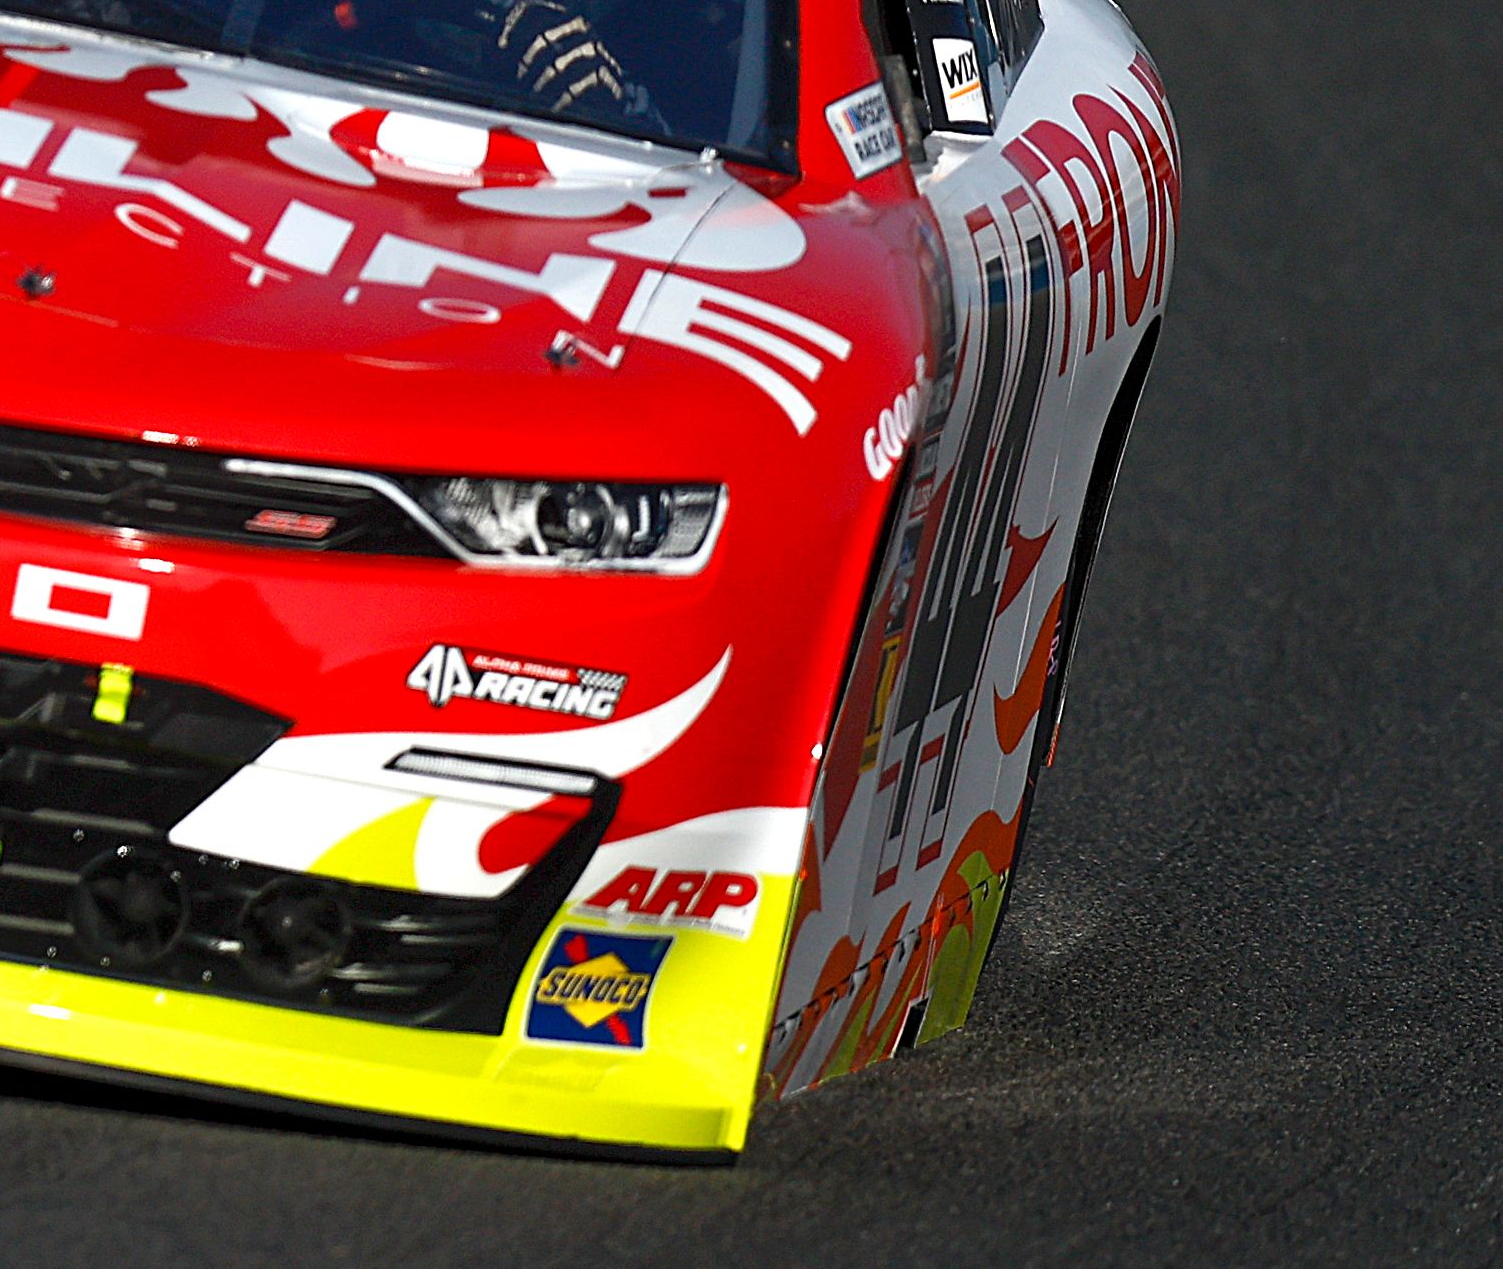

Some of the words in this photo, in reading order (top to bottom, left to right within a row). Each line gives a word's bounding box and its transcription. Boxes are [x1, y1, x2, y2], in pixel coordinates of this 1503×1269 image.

[942, 49, 978, 89] WIX
[474, 670, 623, 720] RACING
[584, 865, 759, 920] ARP
[544, 967, 646, 1012] SUNOCO
